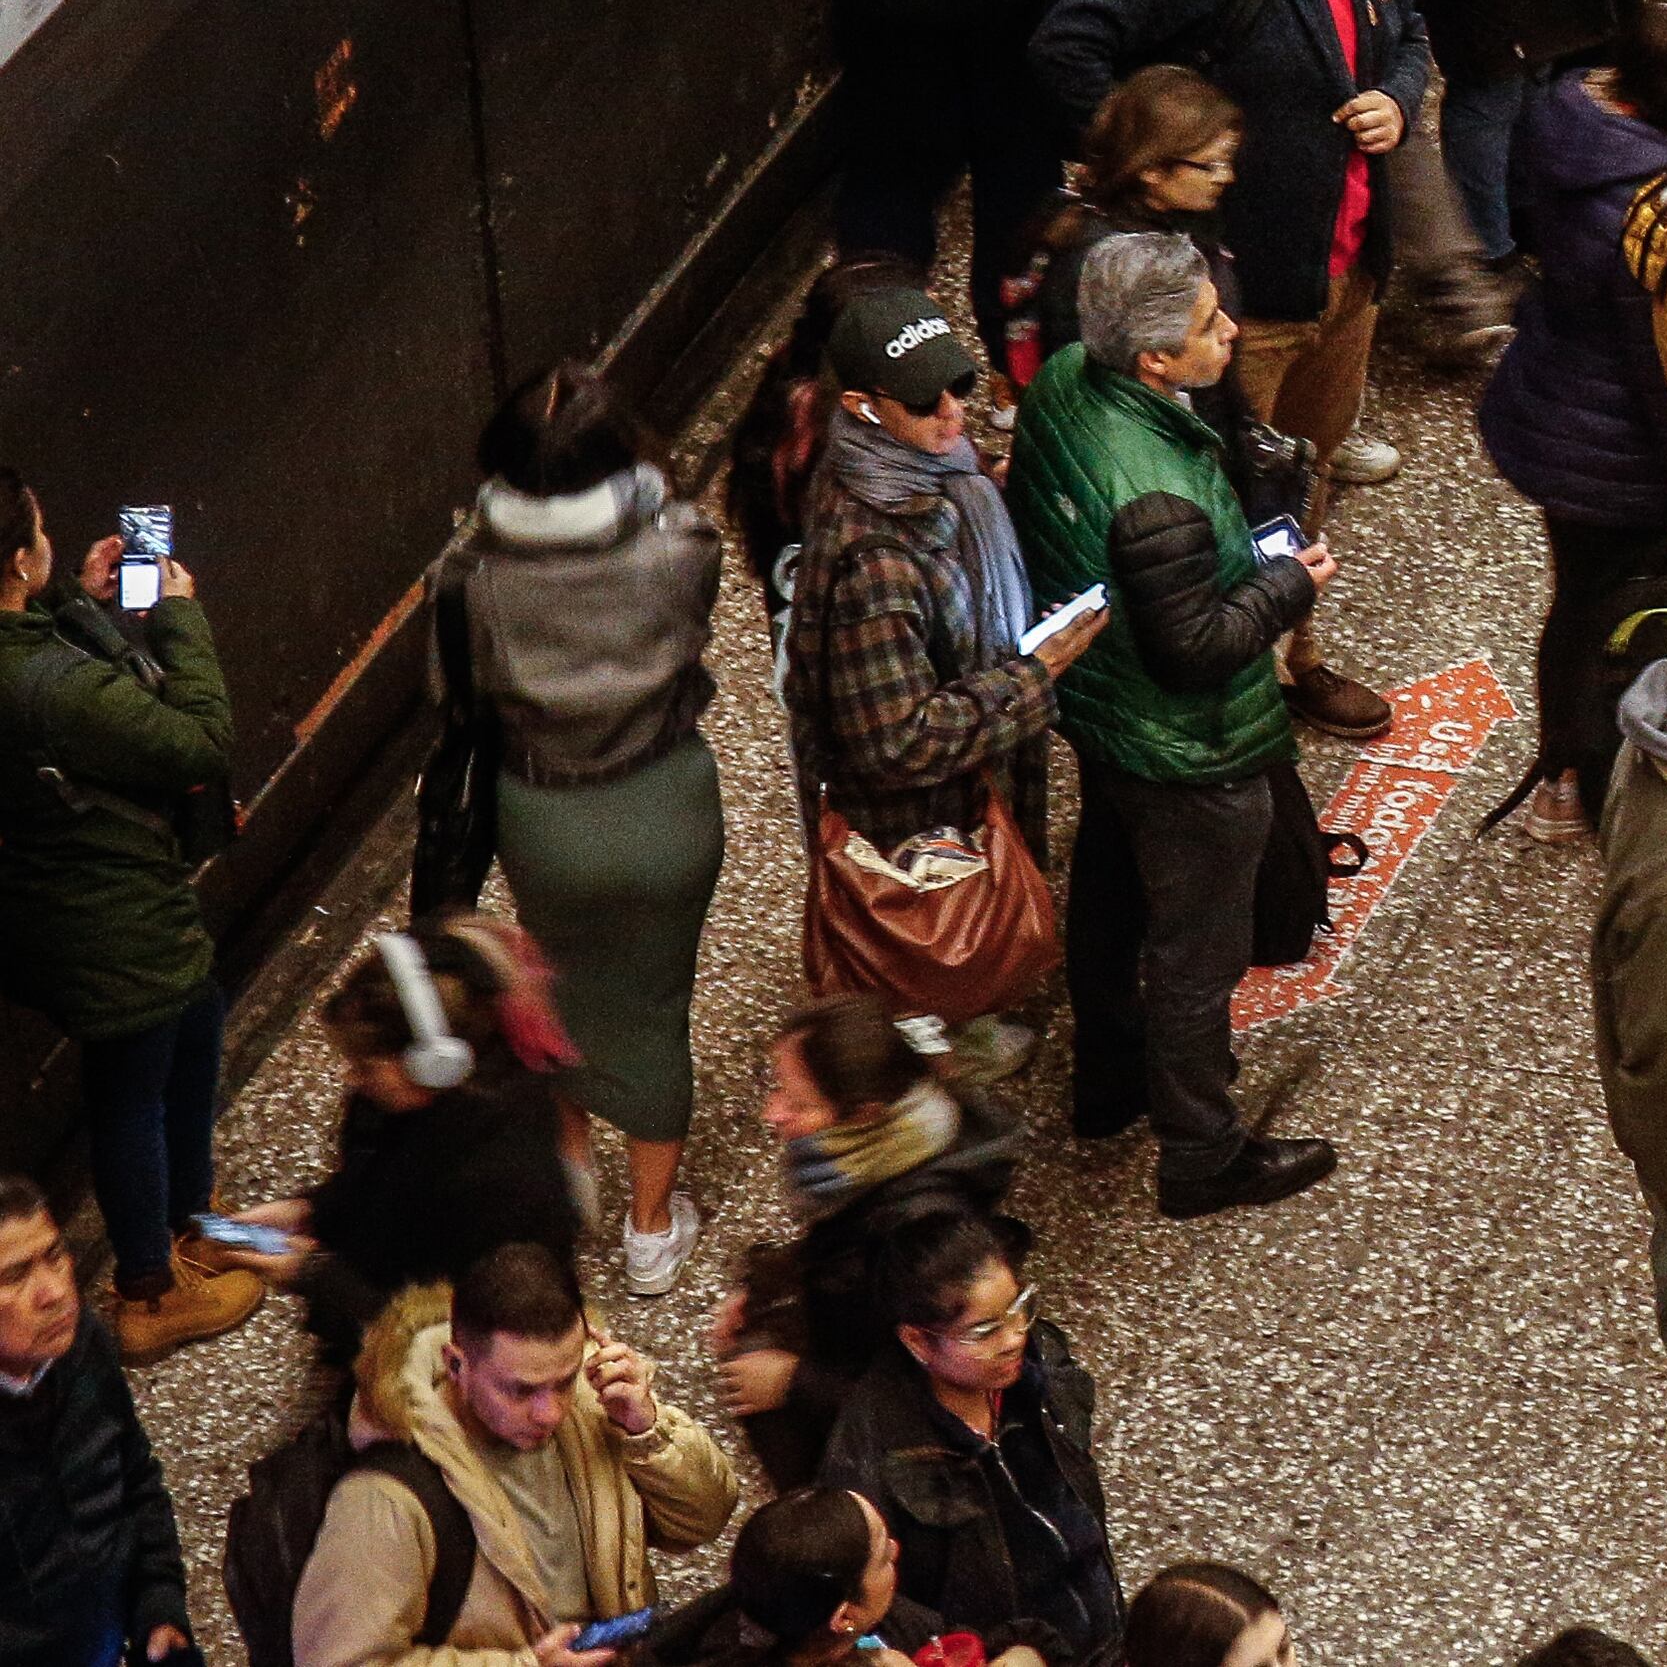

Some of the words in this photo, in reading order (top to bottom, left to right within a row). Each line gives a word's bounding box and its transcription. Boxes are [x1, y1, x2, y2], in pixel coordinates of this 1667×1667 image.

[884, 316, 952, 359] adidas
[1407, 719, 1474, 772] Usa
[1361, 778, 1436, 847] todo
